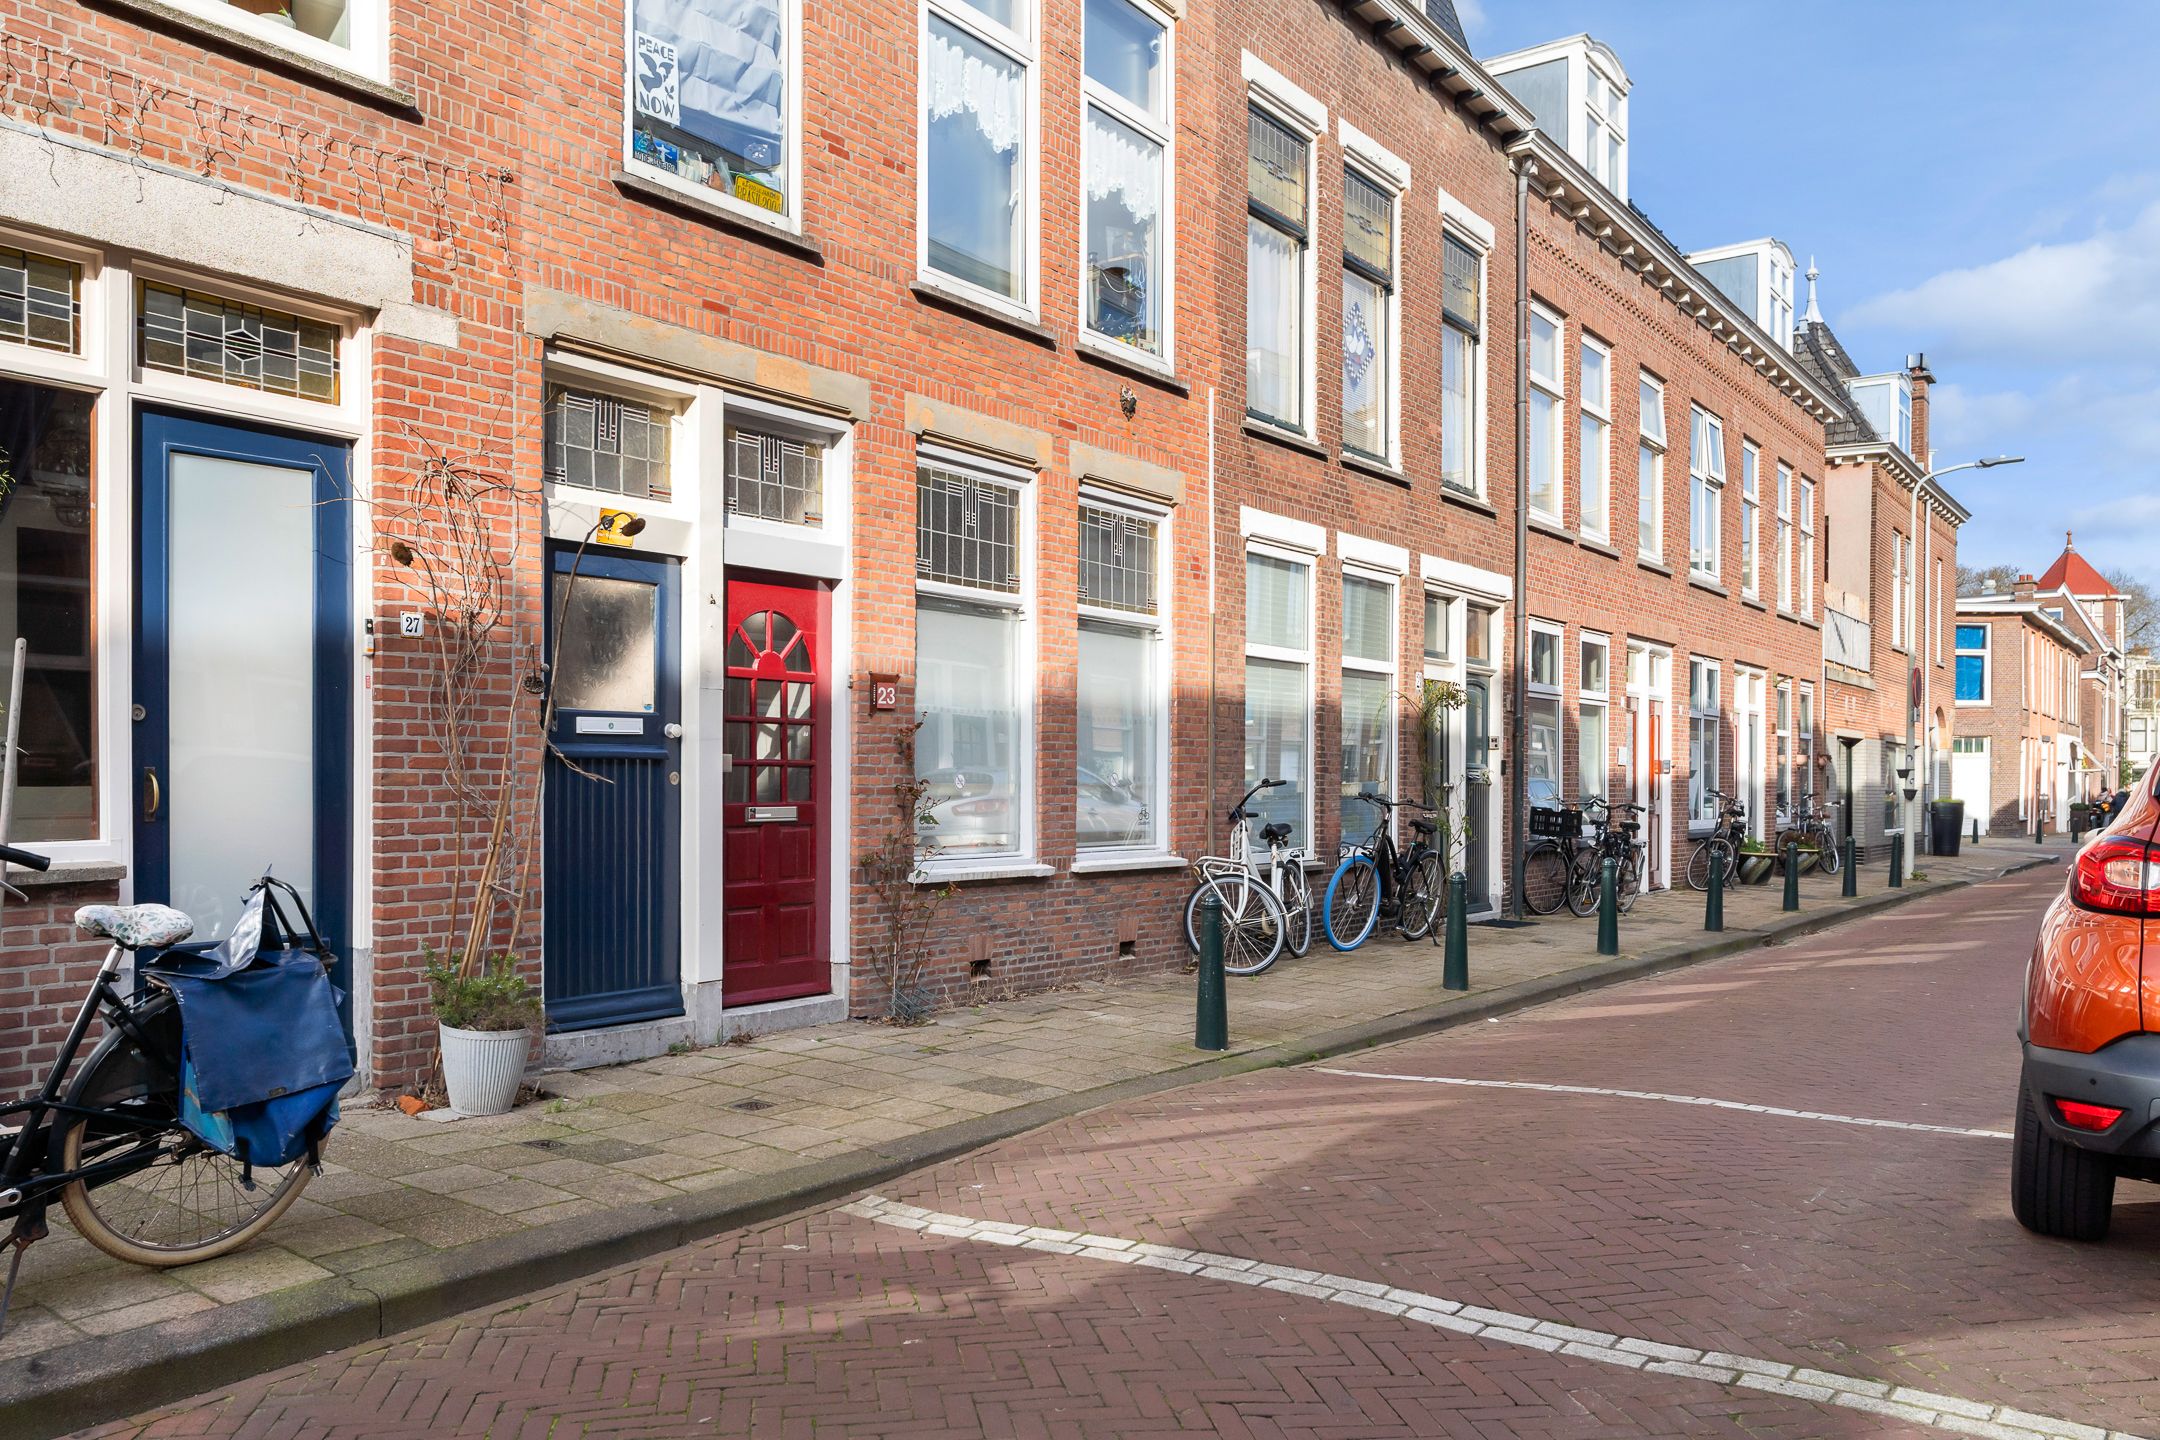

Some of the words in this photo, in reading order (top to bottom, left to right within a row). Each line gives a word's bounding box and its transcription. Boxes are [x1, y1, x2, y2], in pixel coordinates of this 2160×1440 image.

[638, 36, 674, 62] PEACE
[640, 91, 675, 118] NOW
[405, 616, 419, 633] 27
[877, 686, 896, 704] 23
